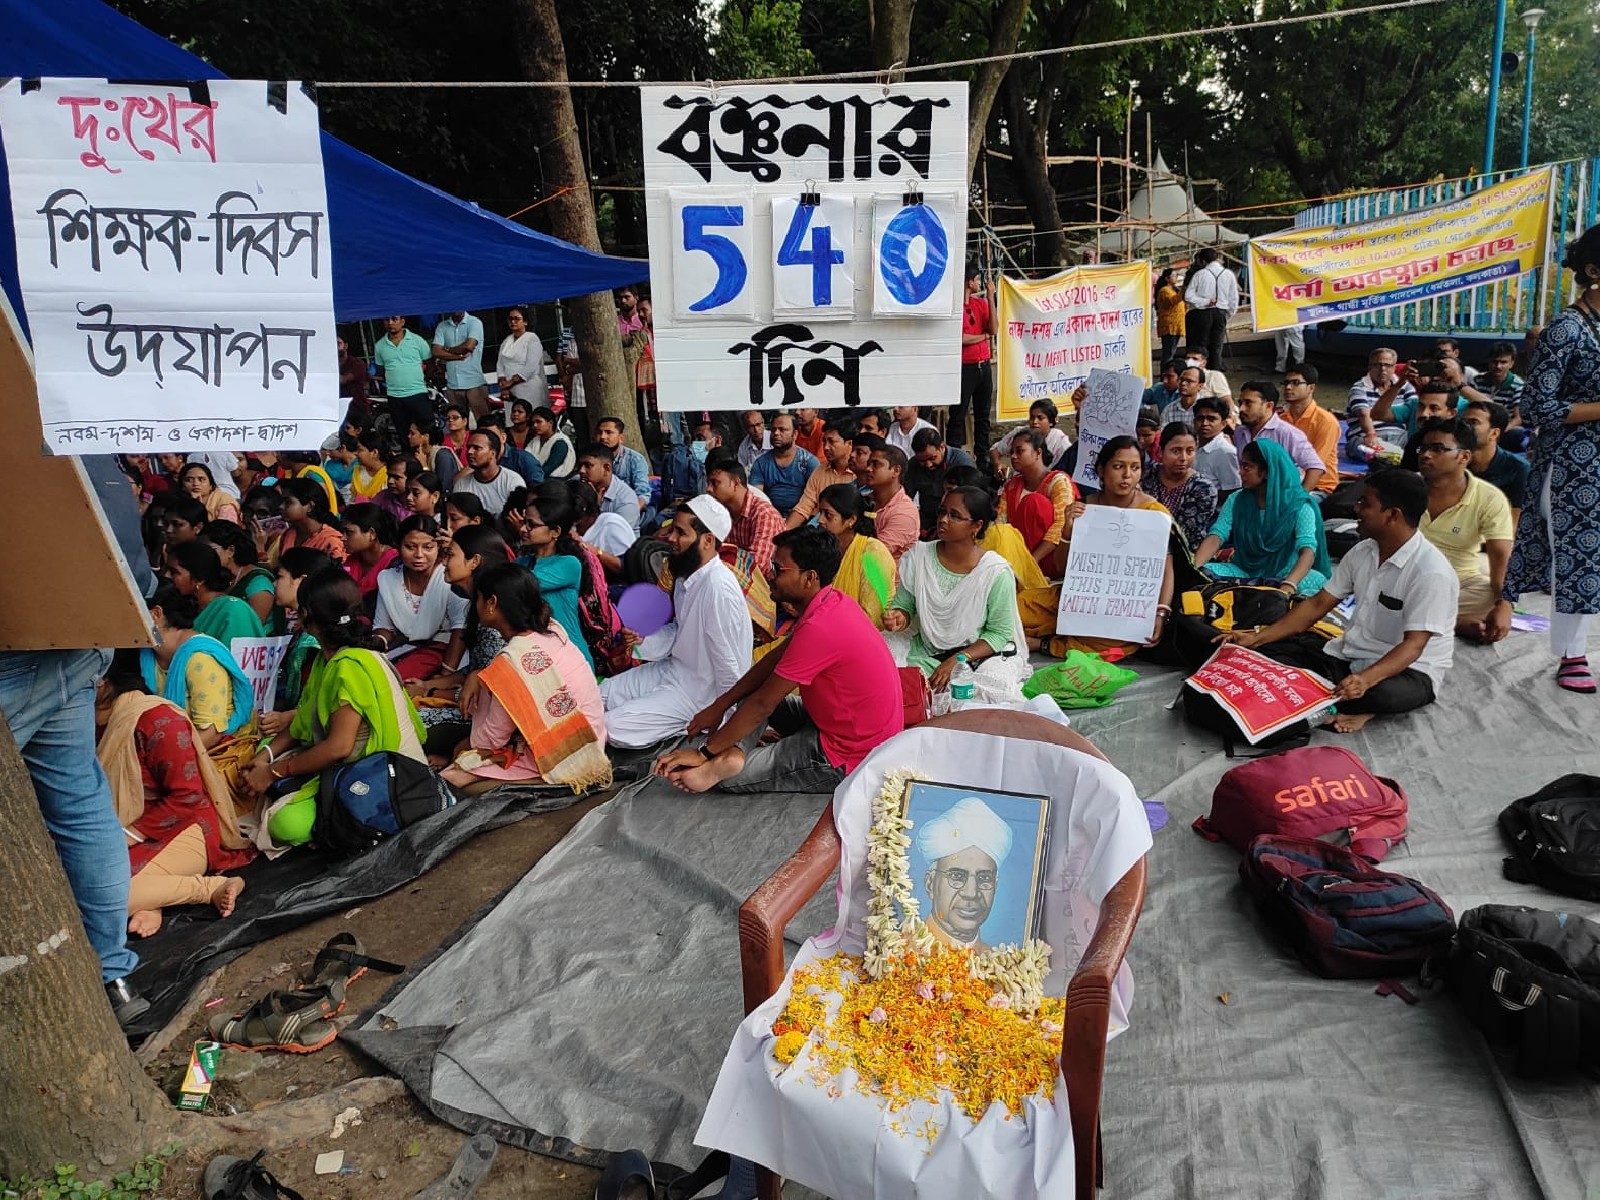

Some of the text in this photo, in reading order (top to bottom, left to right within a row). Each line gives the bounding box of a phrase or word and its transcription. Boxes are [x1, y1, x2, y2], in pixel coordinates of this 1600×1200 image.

[57, 93, 219, 174] দুঃখের
[681, 204, 949, 312] 540
[1332, 254, 1440, 292] অবস্থান
[727, 323, 885, 406] দিন
[1025, 353, 1041, 368] ALL
[1071, 345, 1102, 363] LISTED
[1104, 335, 1126, 358] চাকরি
[1071, 552, 1163, 579] WISH TO SPEND
[1069, 575, 1102, 594] THIS
[1106, 579, 1137, 596] PUJA
[1062, 594, 1154, 618] WITH FAMILY
[1274, 773, 1368, 813] safari
